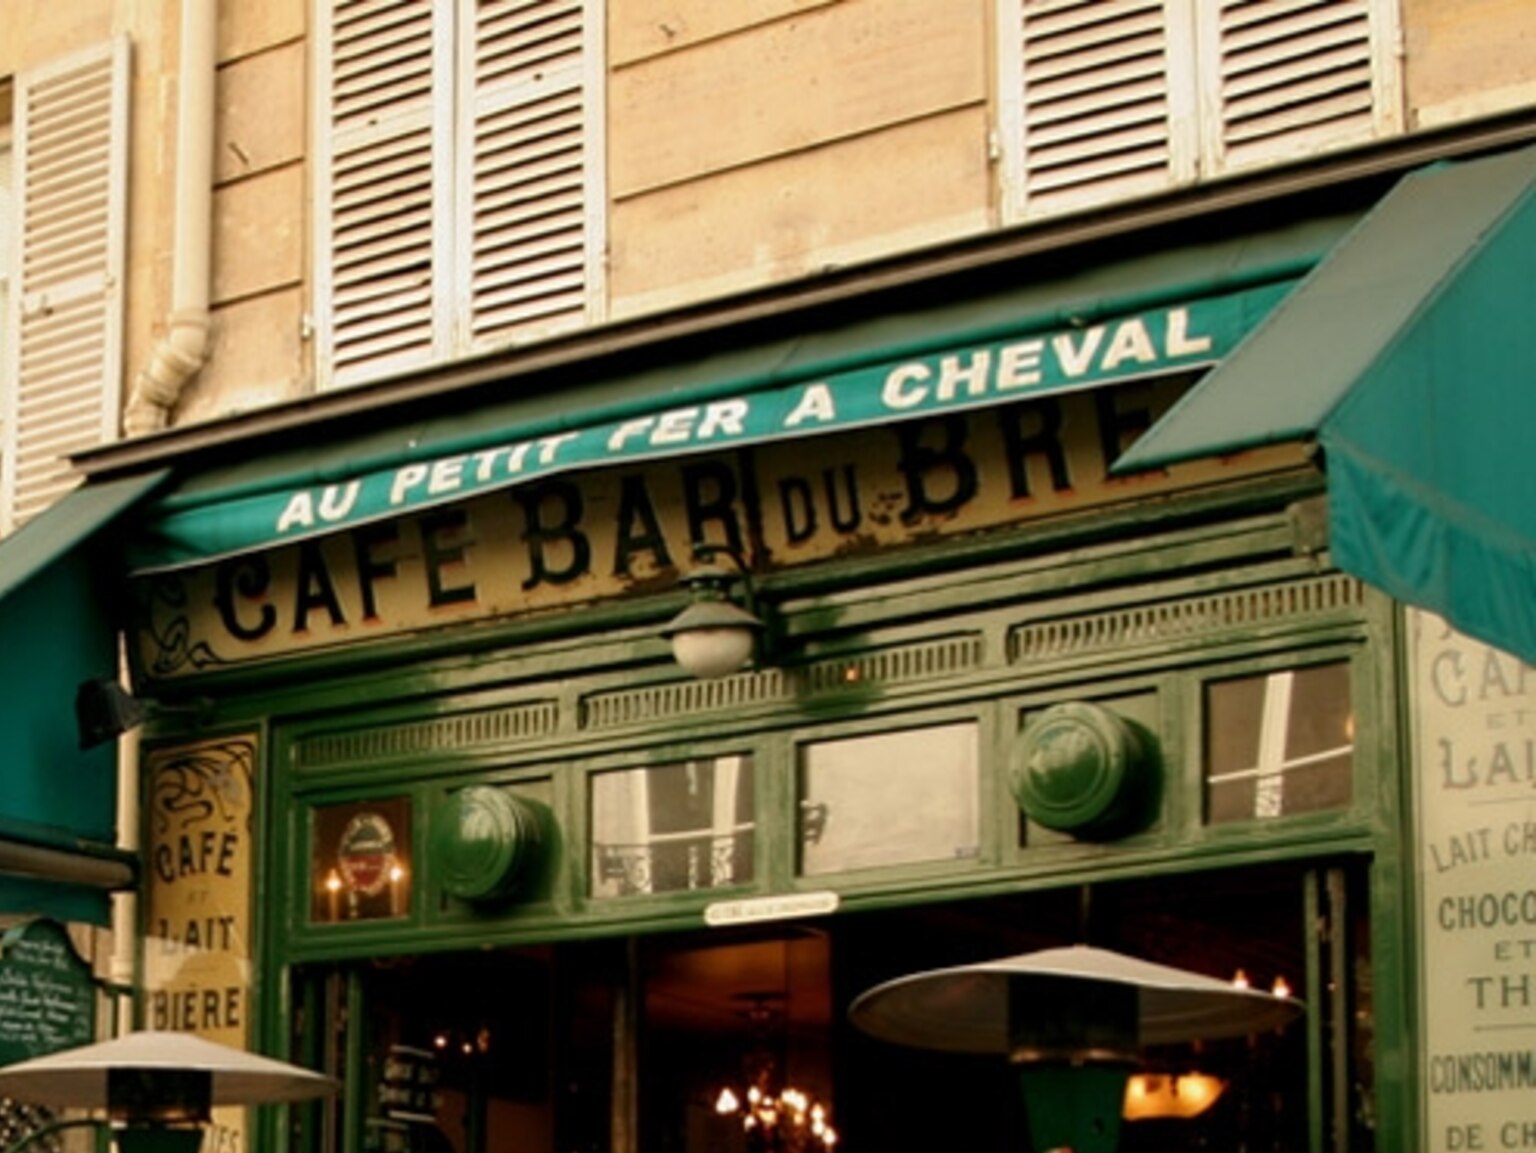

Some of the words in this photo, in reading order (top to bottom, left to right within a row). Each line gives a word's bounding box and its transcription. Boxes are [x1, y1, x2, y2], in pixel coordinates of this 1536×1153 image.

[276, 480, 364, 534] AU
[390, 431, 578, 504] PETIT
[607, 398, 750, 453] FER
[784, 383, 836, 427] A
[881, 308, 1213, 409] CHEVAL
[518, 455, 746, 594] BAR
[779, 463, 863, 547] DU
[896, 384, 1150, 520] BRE
[1438, 736, 1536, 790] LAI
[1428, 825, 1492, 873] LAIT
[1502, 820, 1536, 857] CH
[1437, 889, 1536, 932] CHOCO
[159, 915, 235, 955] LAIT
[1494, 939, 1536, 962] ET
[1466, 974, 1530, 1010] TH
[1429, 1051, 1536, 1094] CONSOMM
[1446, 1123, 1485, 1151] DE
[1501, 1121, 1536, 1149] CH
